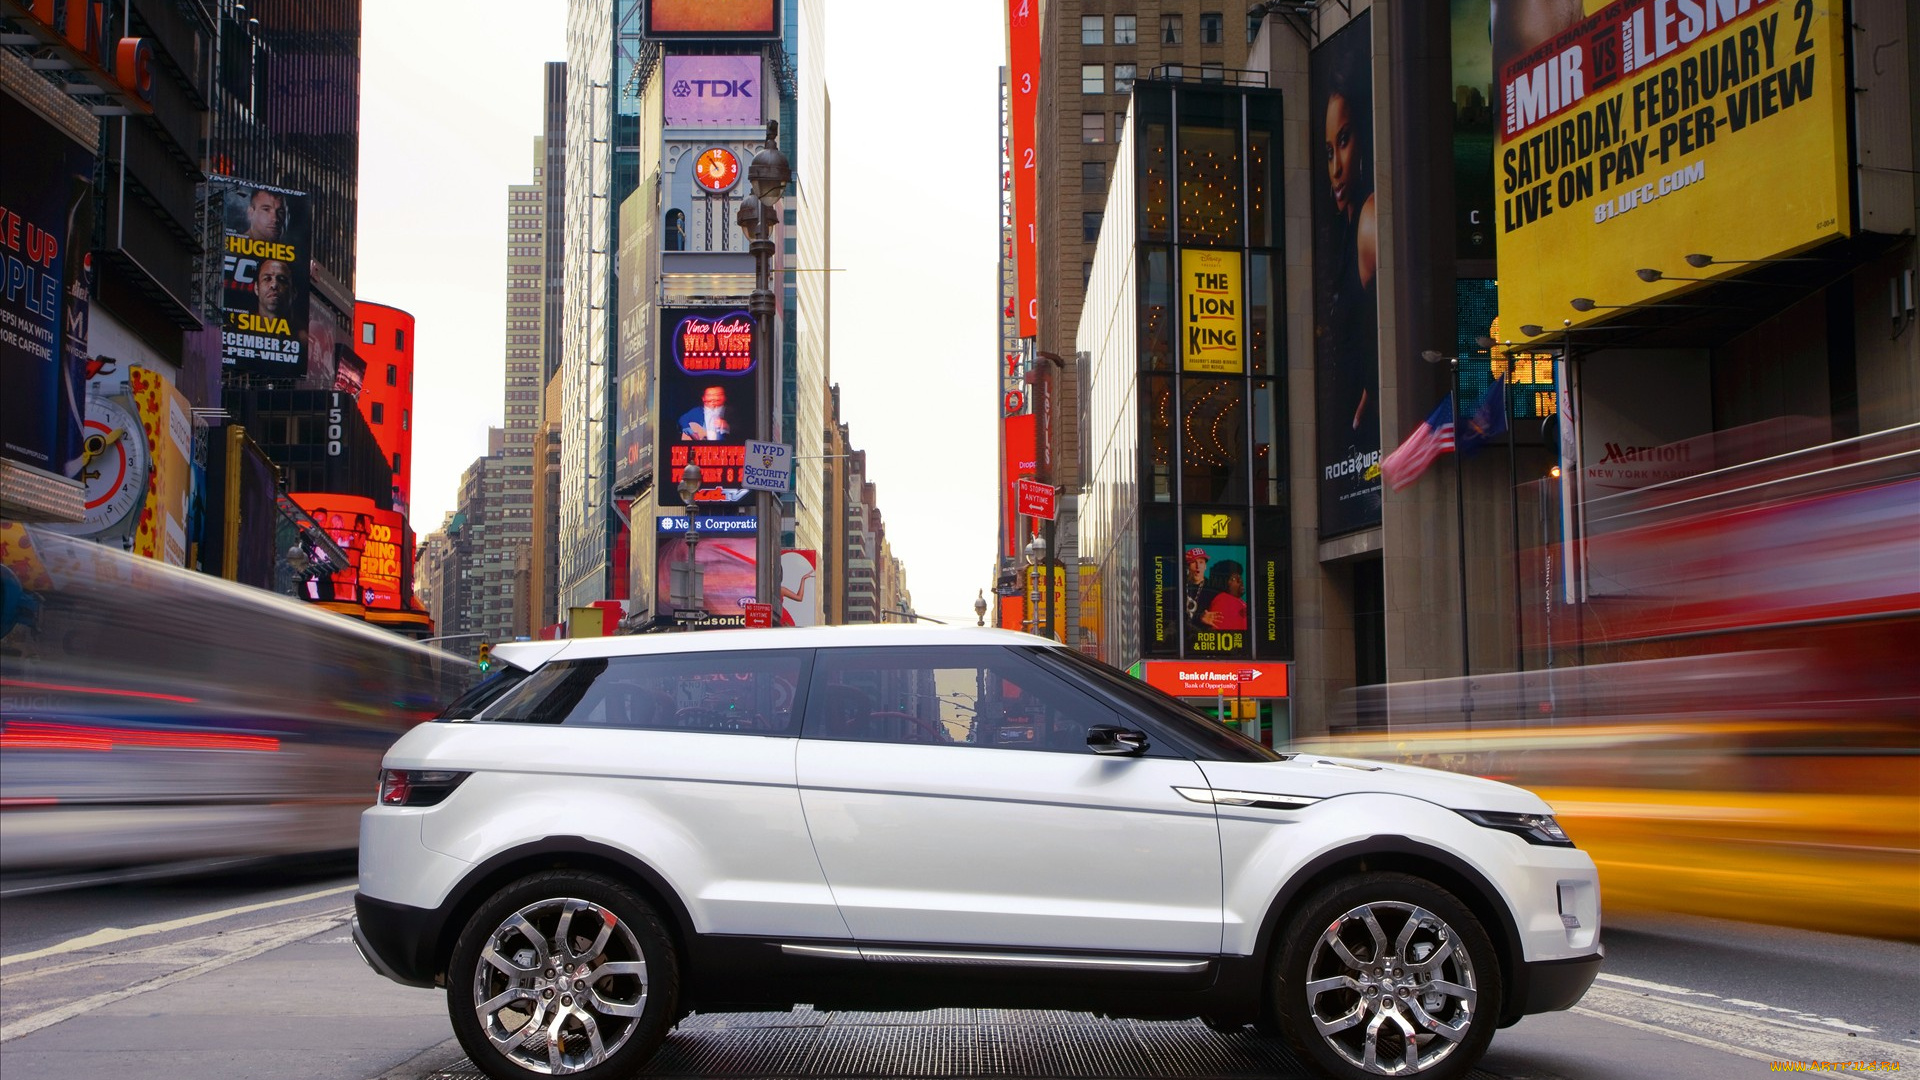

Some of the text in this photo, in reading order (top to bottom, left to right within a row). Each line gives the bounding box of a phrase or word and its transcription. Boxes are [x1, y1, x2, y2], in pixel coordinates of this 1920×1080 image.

[1622, 16, 1633, 73] BROCK
[1633, 0, 1766, 70] LESN
[1507, 42, 1554, 78] FORMER
[1557, 18, 1601, 50] CHAMP
[1592, 35, 1617, 80] VS
[691, 79, 753, 97] TDK
[1021, 73, 1032, 93] 3
[1516, 44, 1584, 131] MIR
[1503, 0, 1815, 195] SATURDAY, FEBRUARY 2
[1506, 81, 1516, 134] FRANK
[713, 149, 722, 158] 12
[1504, 54, 1816, 233] LIVE ON PAY-PER-VIEW
[697, 164, 737, 173] 9 3
[1023, 148, 1035, 169] 2
[713, 180, 720, 189] 6
[1594, 159, 1706, 224] 81.UFC.COM
[1028, 223, 1034, 245] 1
[26, 222, 58, 268] UP
[229, 235, 297, 262] HUGHES
[1195, 272, 1229, 290] THE
[1189, 294, 1235, 323] LION
[18, 317, 35, 337] MAX
[34, 324, 54, 344] WITH
[237, 313, 292, 336] SILVA
[622, 302, 651, 344] PLANET
[684, 319, 751, 339] Vince Vaughn's
[18, 336, 52, 362] CAFFEINE
[282, 339, 301, 354] 29
[683, 333, 751, 352] WILD WEST
[1189, 326, 1237, 356] KING
[104, 414, 110, 424] 1
[327, 392, 343, 457] 1500
[122, 430, 130, 442] 2
[752, 443, 785, 457] NYPD
[1599, 442, 1691, 466] Marriott
[128, 456, 135, 467] 3
[744, 465, 789, 480] SECURITY
[745, 475, 786, 489] CAMERA
[1588, 468, 1614, 479] NEW
[1617, 469, 1648, 480] YORK
[121, 483, 129, 493] 4
[1021, 484, 1028, 492] NO
[1029, 485, 1053, 496] STOPPING
[105, 504, 114, 514] 5
[1025, 494, 1049, 505] ANYTIME
[674, 517, 702, 530] Nes
[1201, 513, 1232, 539] MTV
[1154, 555, 1164, 642] LIFEOFRYAN.MTV.COM
[1267, 560, 1277, 642] ROBANDBIG.MTV.COM
[677, 615, 747, 627] Pnasonic
[1197, 633, 1215, 642] ROB
[1201, 641, 1216, 651] BIG
[1217, 633, 1233, 651] 10
[1179, 671, 1199, 681] Bank
[1199, 671, 1208, 681] of
[1208, 671, 1238, 681] Americ
[1205, 682, 1236, 690] Opportunity
